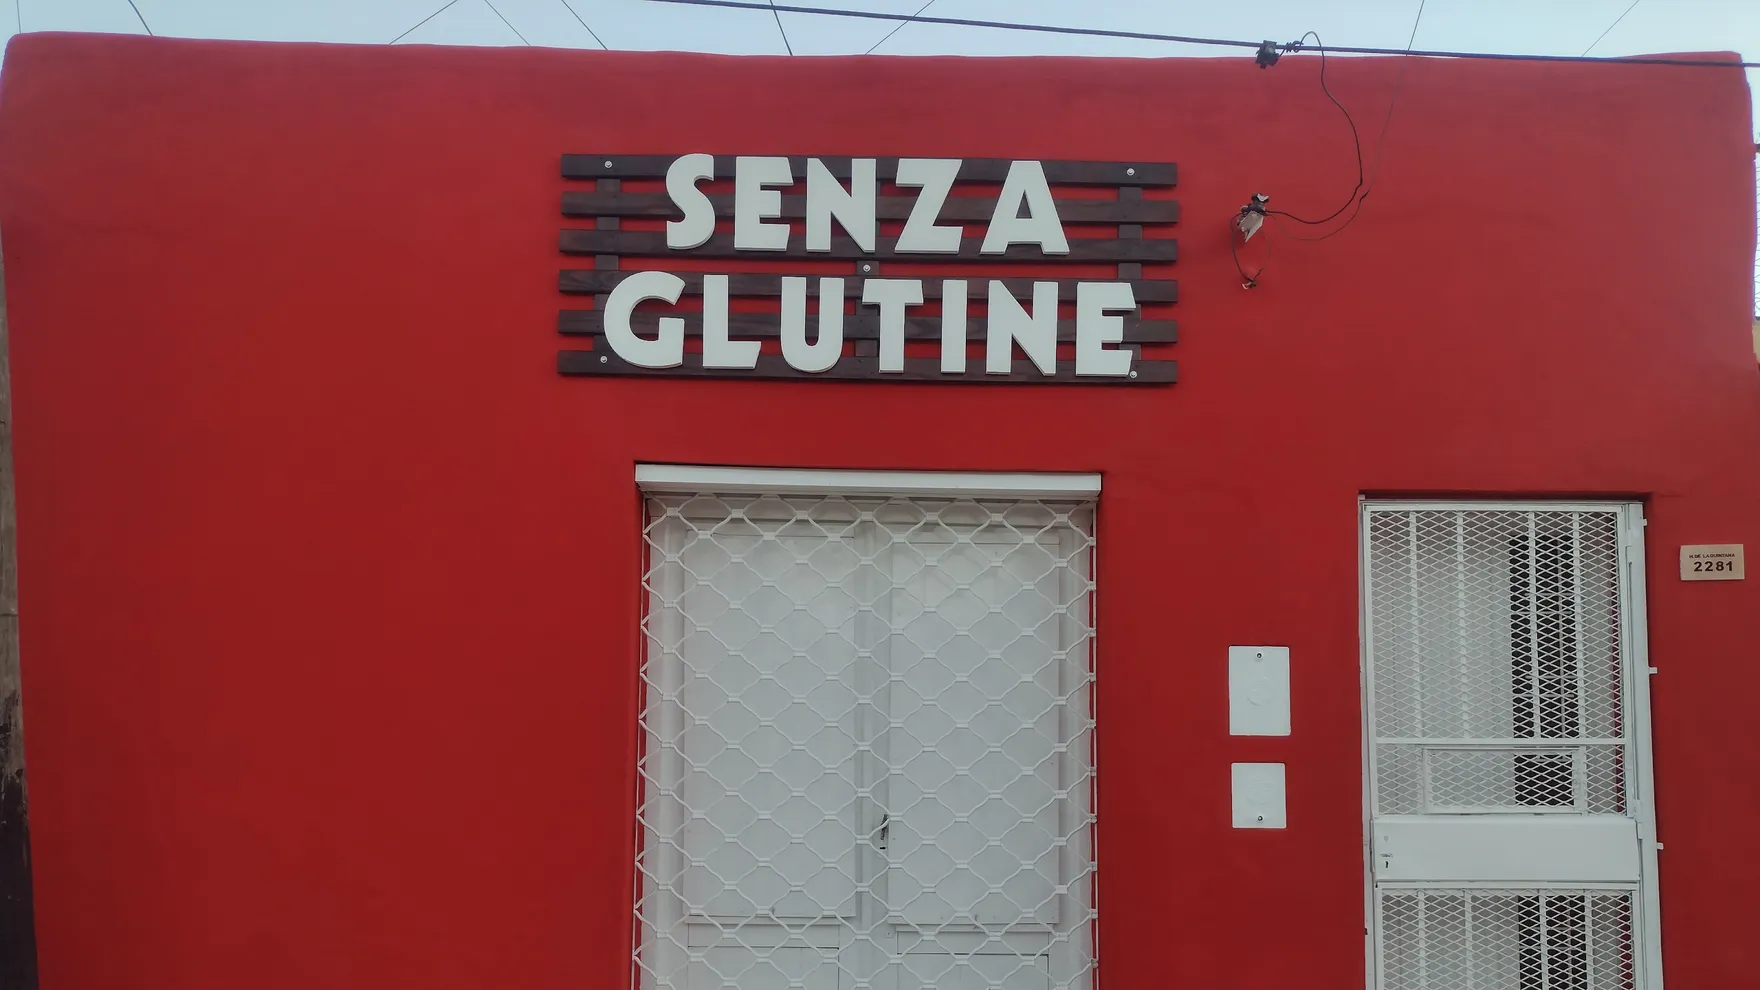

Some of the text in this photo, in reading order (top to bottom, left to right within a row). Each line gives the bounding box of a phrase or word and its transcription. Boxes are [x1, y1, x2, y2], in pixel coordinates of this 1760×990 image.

[665, 153, 1070, 255] SENZA
[603, 270, 1137, 377] GLUTINE
[1694, 561, 1733, 572] 2281
